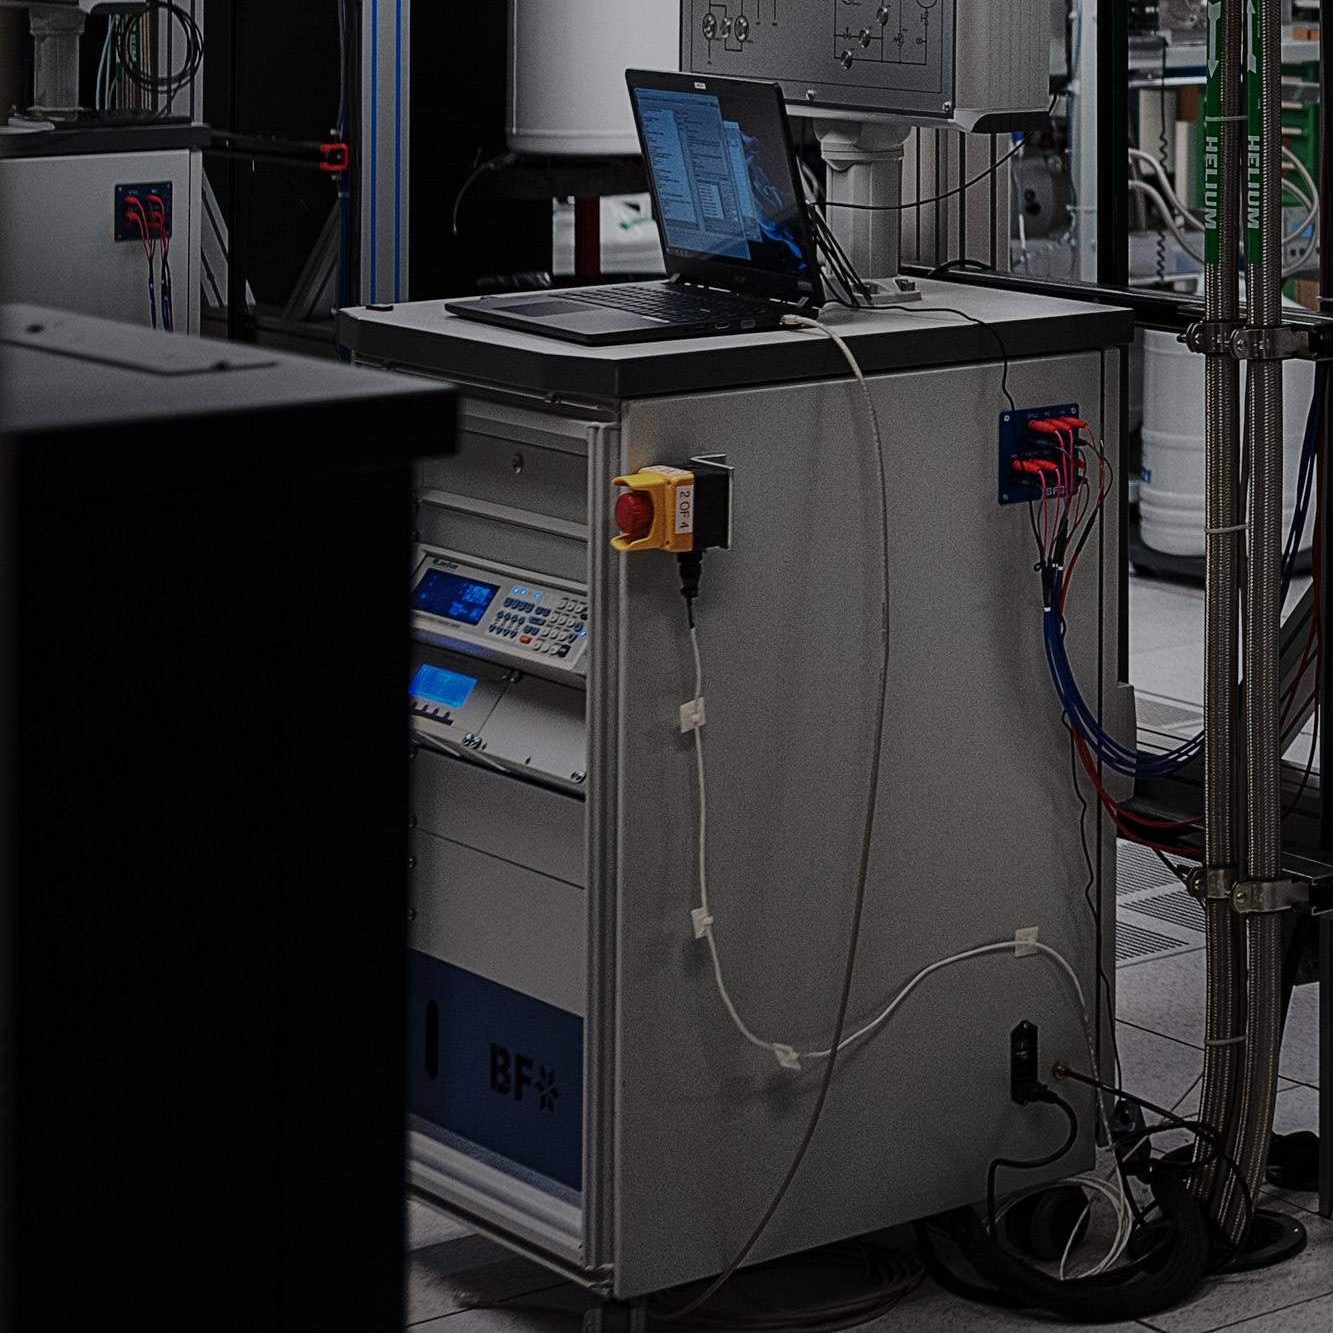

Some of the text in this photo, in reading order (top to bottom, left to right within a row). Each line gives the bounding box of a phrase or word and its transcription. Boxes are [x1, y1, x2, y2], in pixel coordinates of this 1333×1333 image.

[1205, 136, 1218, 229] HELIUM
[1248, 135, 1260, 229] HELIUM
[680, 501, 690, 519] OF
[490, 1042, 533, 1101] BF
